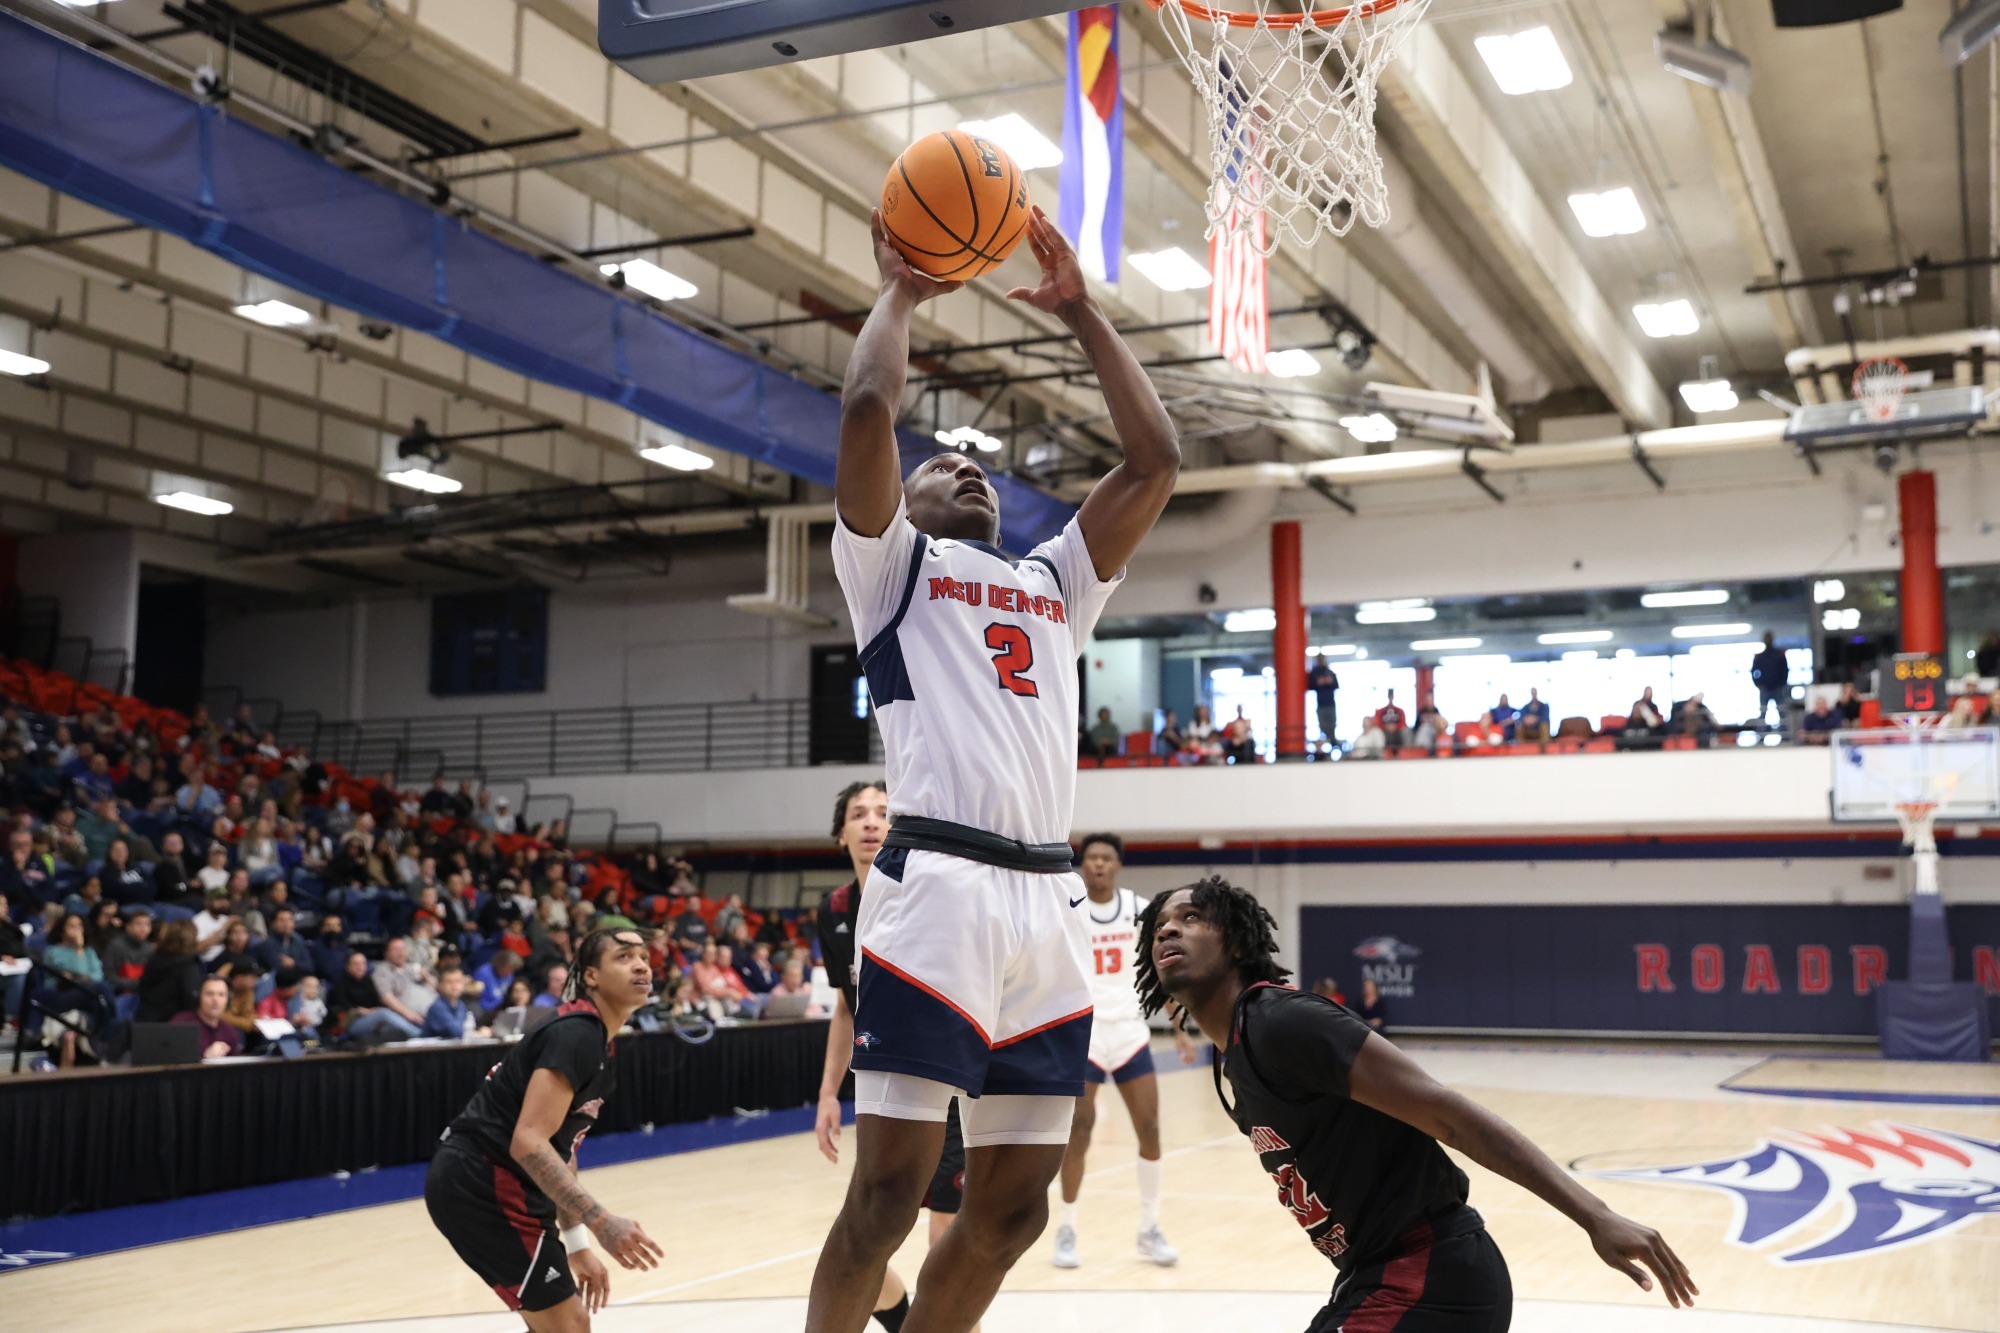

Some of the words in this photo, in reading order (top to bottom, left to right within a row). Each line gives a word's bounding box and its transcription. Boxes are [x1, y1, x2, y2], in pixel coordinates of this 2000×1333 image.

[971, 136, 1003, 178] CAA
[928, 577, 982, 606] MSU
[988, 584, 1066, 624] DENVER
[984, 622, 1039, 698] 2
[1093, 947, 1121, 975] 13
[1362, 964, 1413, 984] MSU
